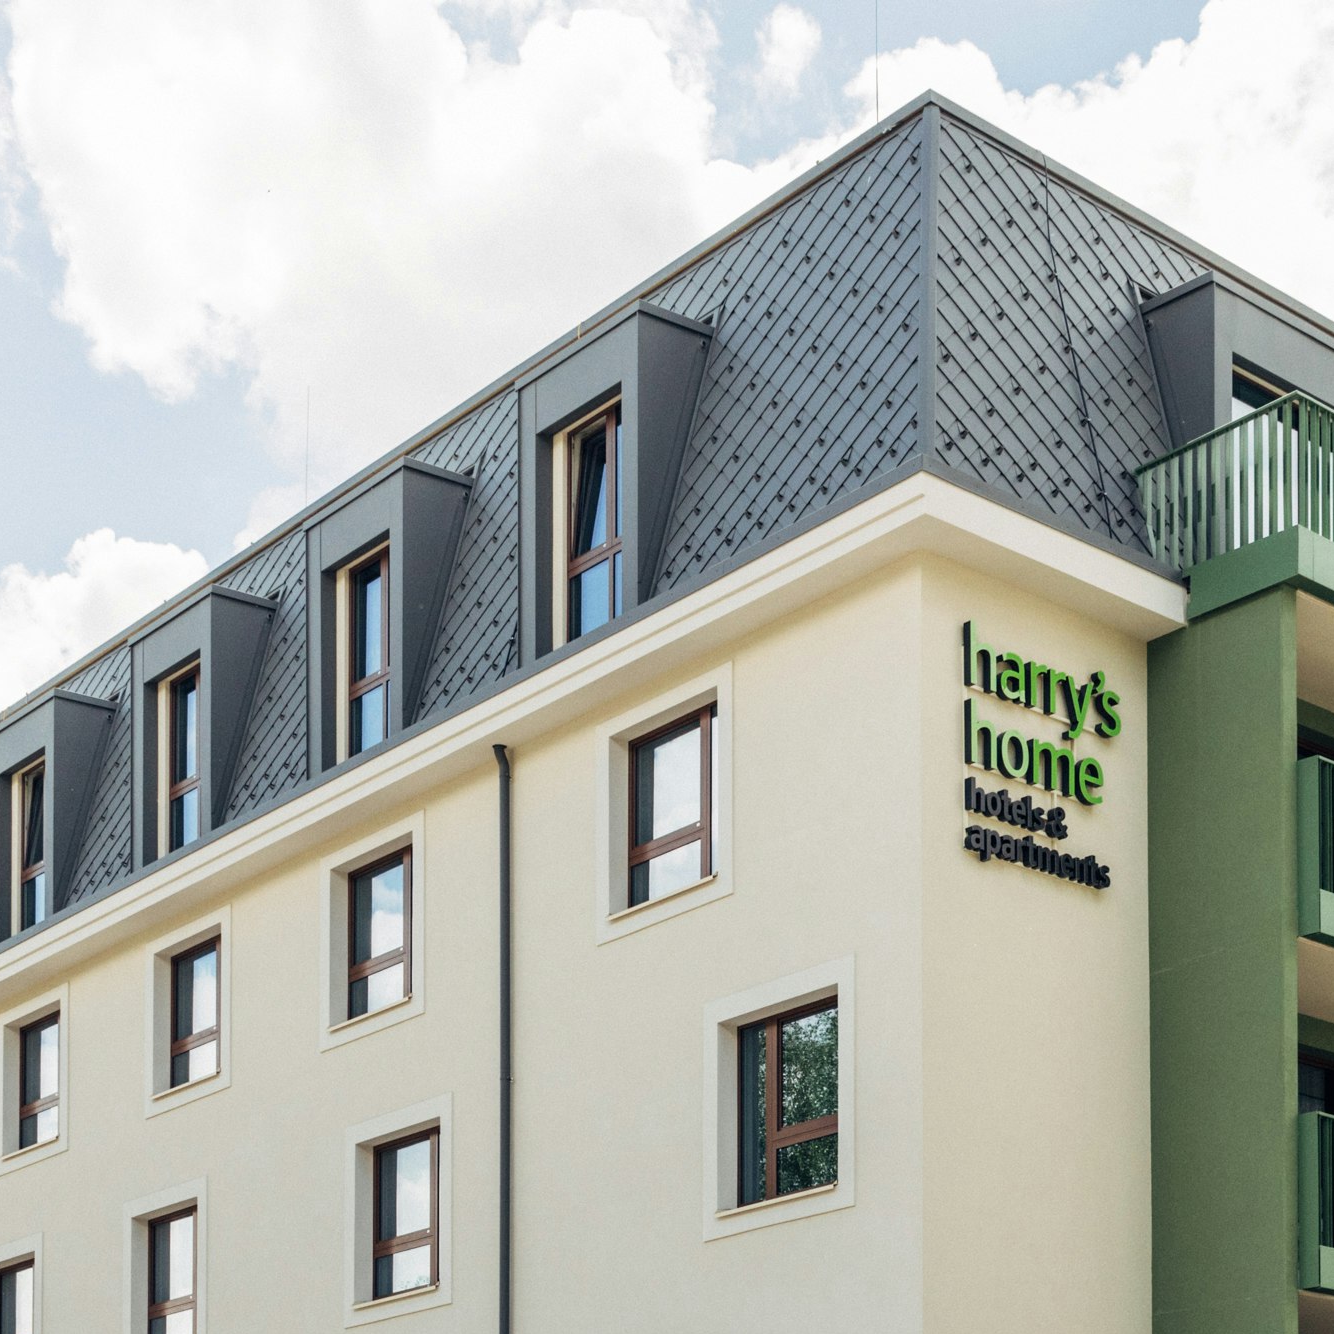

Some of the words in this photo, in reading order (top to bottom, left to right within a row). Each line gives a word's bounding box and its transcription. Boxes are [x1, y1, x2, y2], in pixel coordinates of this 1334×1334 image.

[963, 620, 1122, 741] harry's
[964, 698, 1105, 806] home
[964, 776, 1046, 831] hotels
[1046, 806, 1069, 840] &
[964, 823, 1111, 890] apartments
